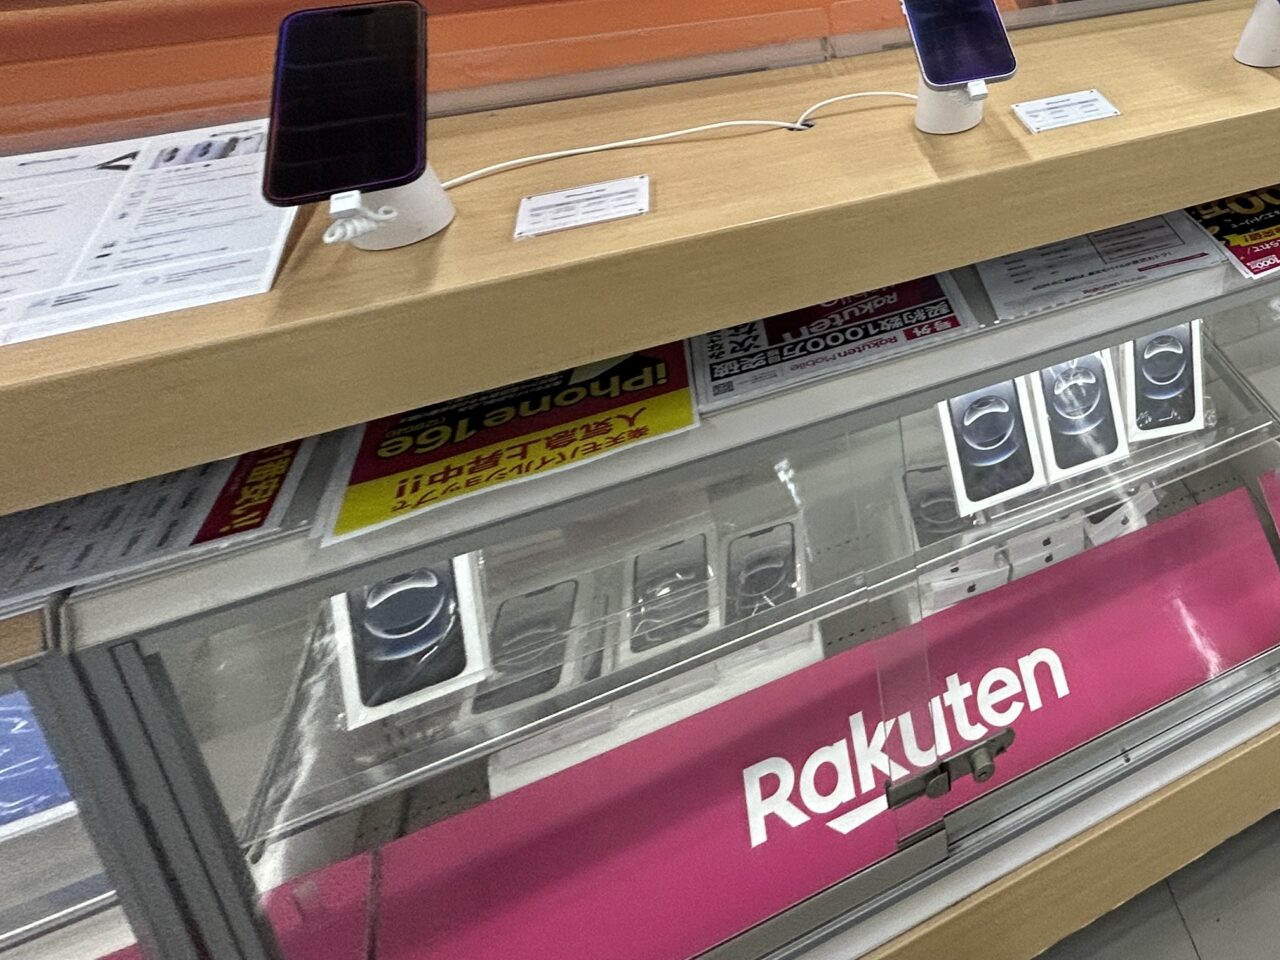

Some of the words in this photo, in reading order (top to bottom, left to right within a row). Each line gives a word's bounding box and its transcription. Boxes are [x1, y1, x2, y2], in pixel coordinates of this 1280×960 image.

[781, 292, 898, 341] Rakuten
[911, 319, 952, 339] 号外
[789, 351, 837, 373] Mobile
[836, 335, 898, 360] Rakuten
[483, 362, 668, 430] iPhone
[376, 416, 479, 460] 16e
[394, 406, 648, 499] 人気急上昇中!!
[389, 425, 650, 513] 楽天モバイルショップで
[741, 647, 1070, 849] Rakuten
